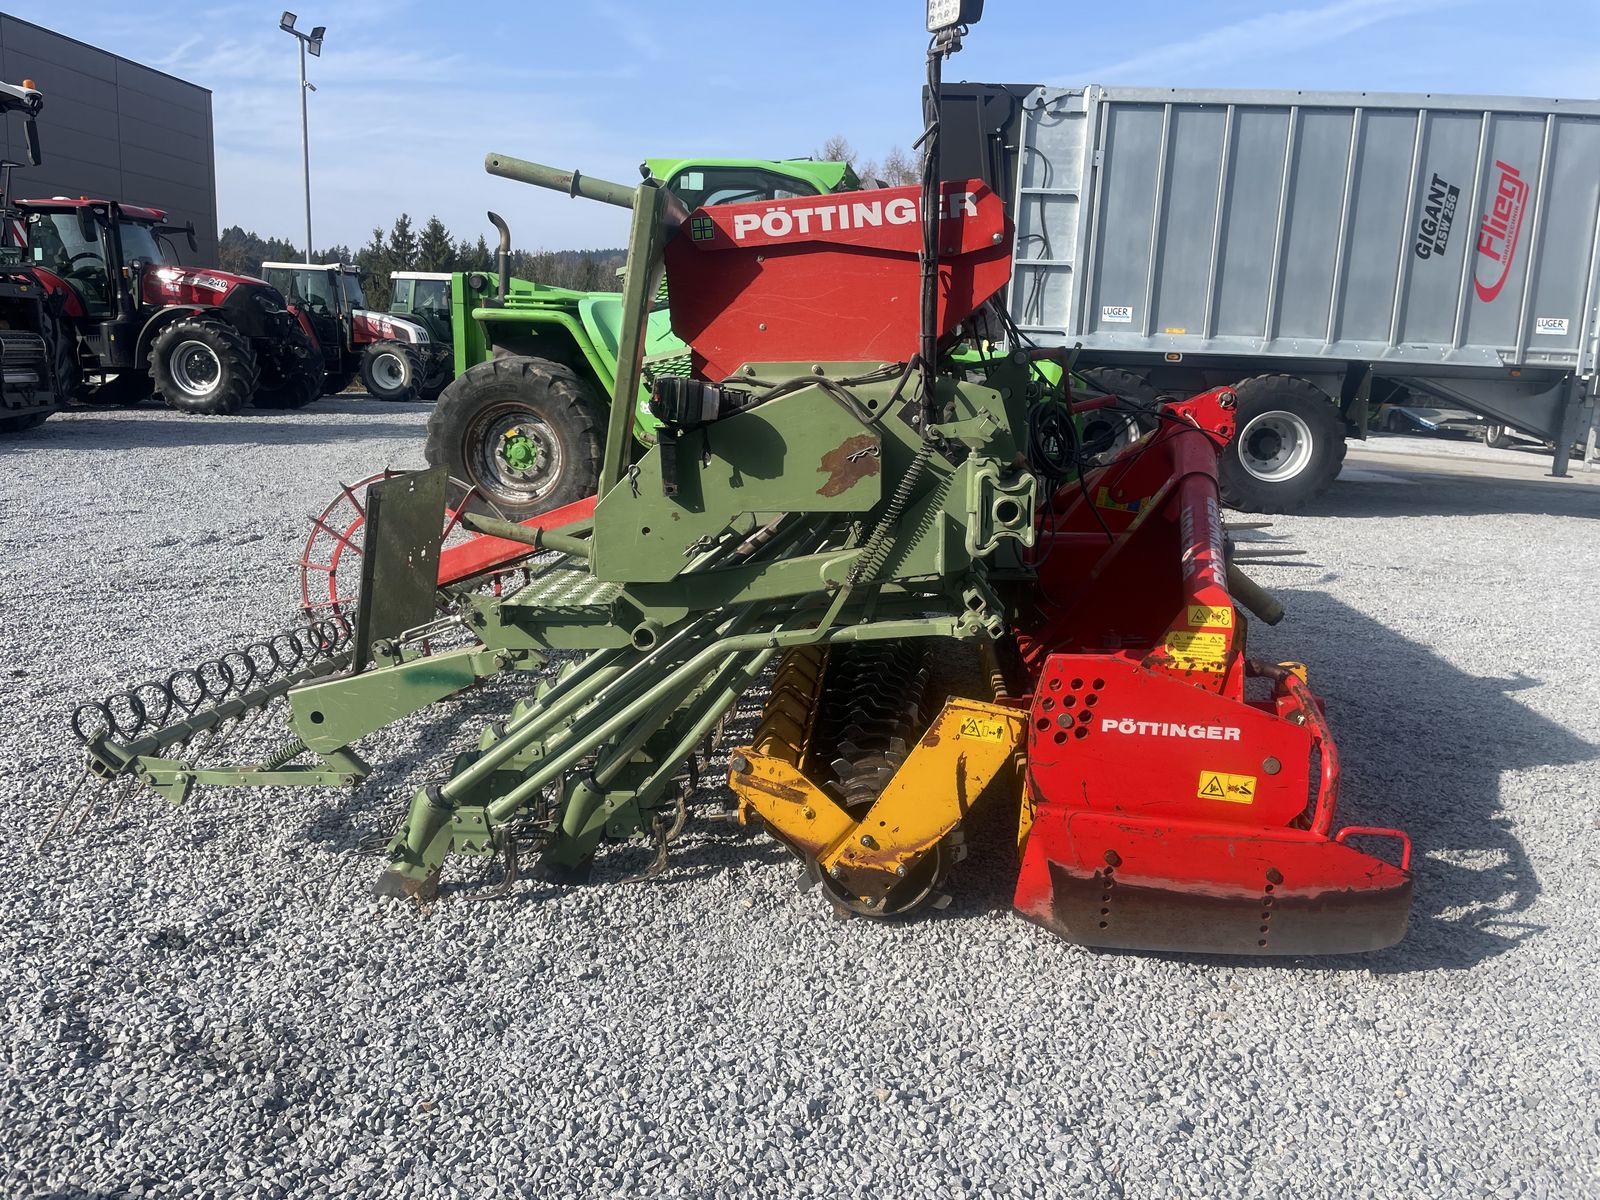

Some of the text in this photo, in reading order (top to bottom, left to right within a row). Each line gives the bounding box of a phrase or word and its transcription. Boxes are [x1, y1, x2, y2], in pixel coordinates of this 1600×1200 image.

[1415, 173, 1448, 260] GIGANT
[1436, 193, 1457, 250] ASW 256
[1477, 160, 1524, 261] Fliegl
[208, 278, 227, 288] 240
[1103, 307, 1128, 316] LUGER
[1537, 319, 1564, 328] LUGER
[1101, 718, 1241, 741] PÖTTINGER
